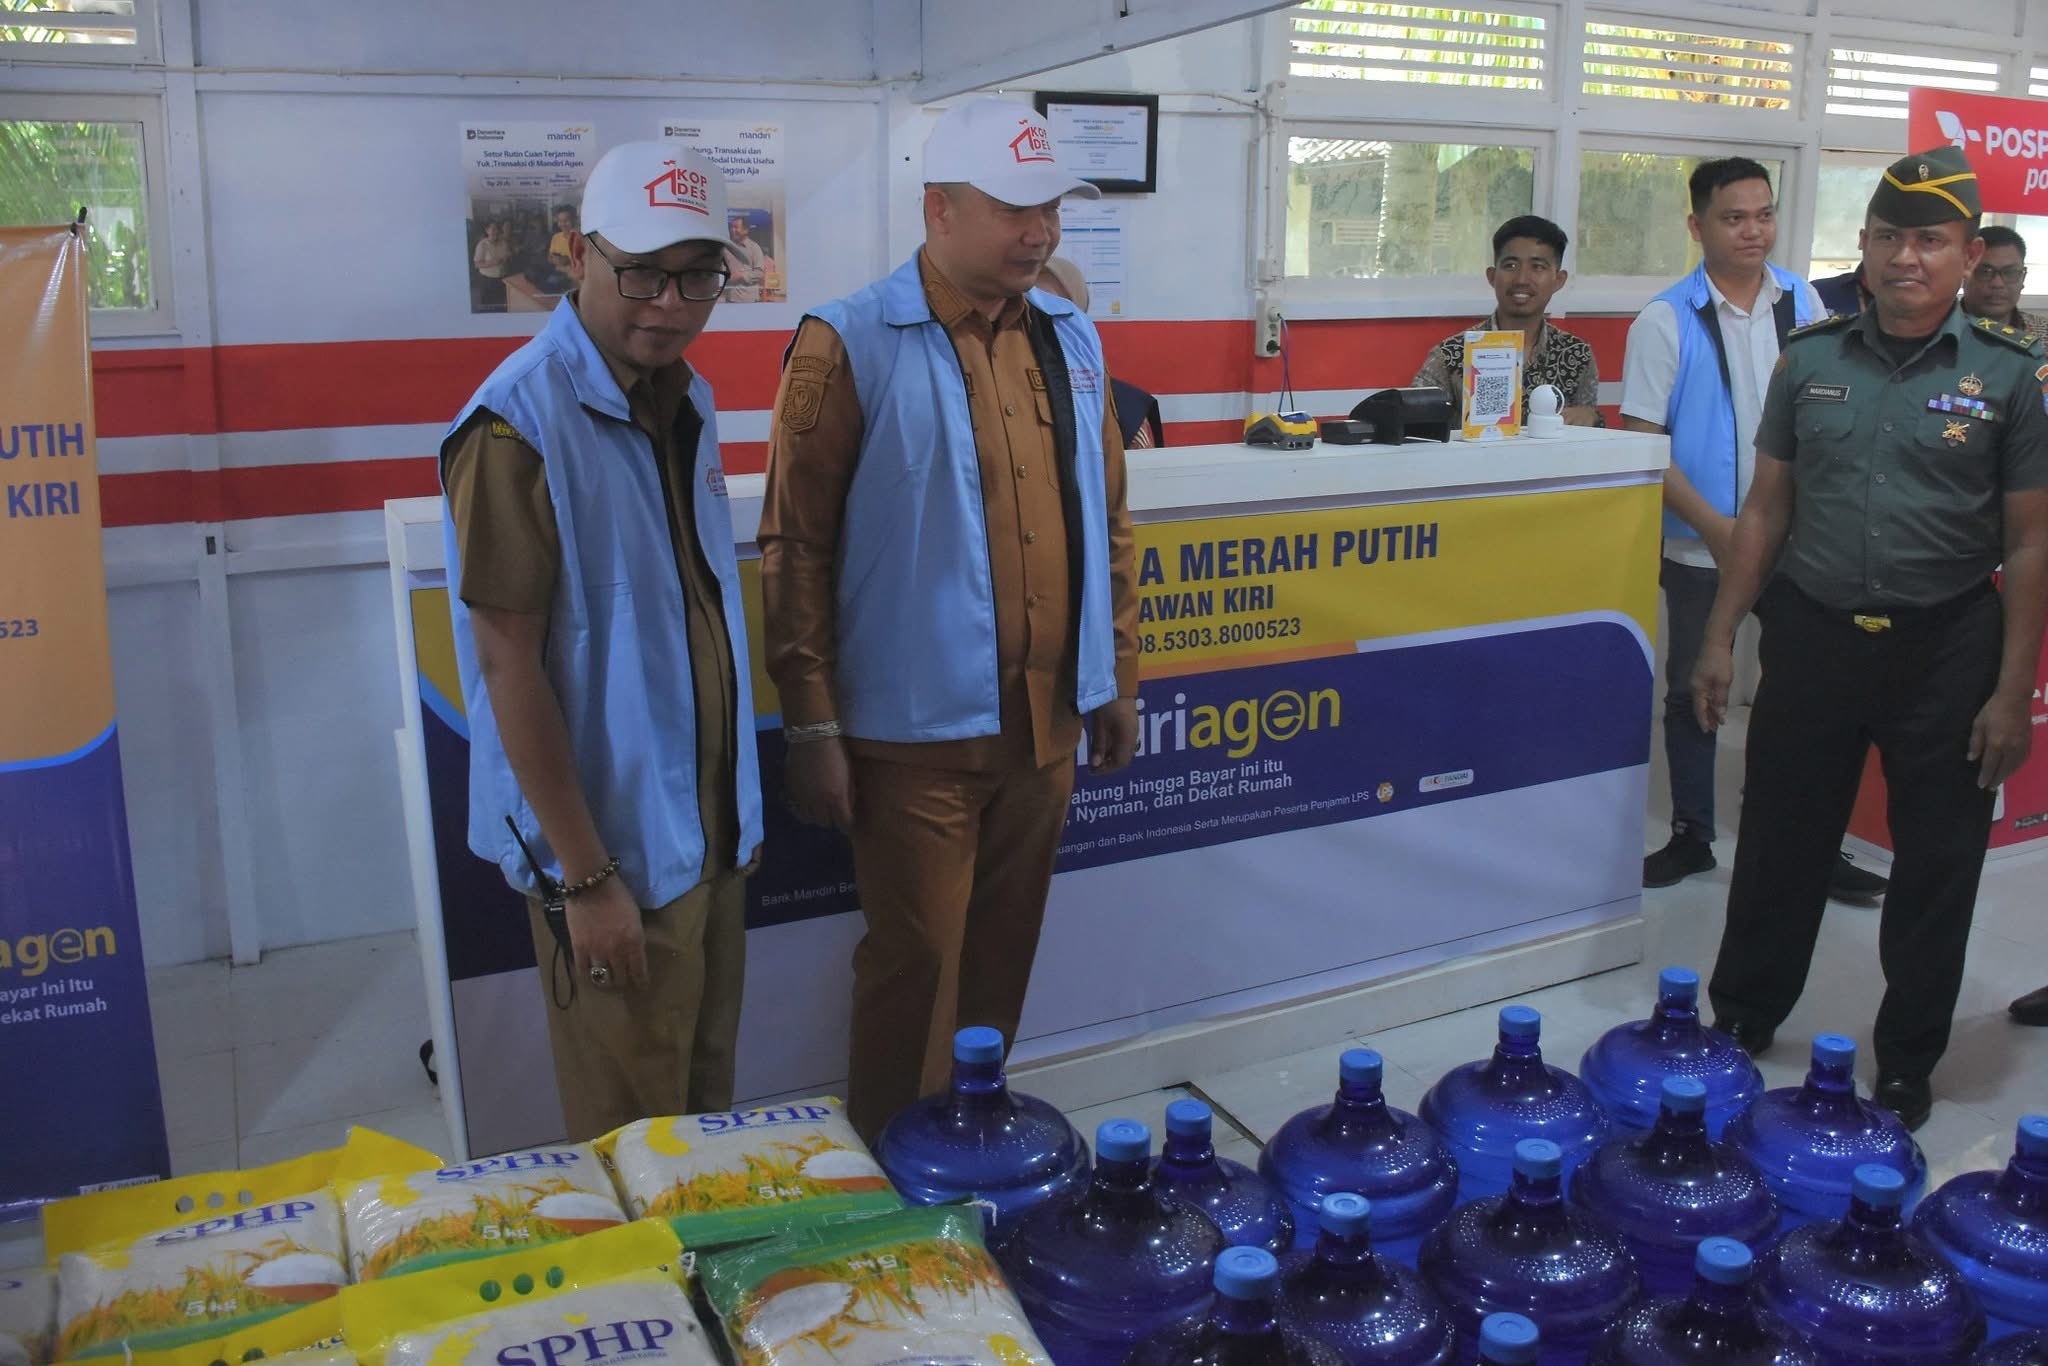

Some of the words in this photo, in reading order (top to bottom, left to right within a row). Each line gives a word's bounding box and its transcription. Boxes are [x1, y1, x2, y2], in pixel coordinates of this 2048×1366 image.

[547, 131, 580, 140] mandiri
[739, 131, 771, 139] mandiri
[483, 150, 502, 158] Setor
[544, 150, 575, 159] Terjamin
[714, 146, 746, 154] Transaksi
[566, 160, 583, 169] Agen
[746, 166, 759, 175] Aja
[677, 168, 707, 186] KOP
[677, 183, 707, 201] DES
[0, 423, 84, 460] UTIH
[7, 481, 80, 518] KIRI
[1138, 547, 1164, 586] A
[1180, 533, 1317, 582] MERAH
[1333, 523, 1438, 567] PUTIH
[1138, 590, 1213, 623] AWAN
[1224, 584, 1273, 613] KIRI
[1072, 785, 1123, 804] abung
[1129, 775, 1184, 795] hingga
[1190, 768, 1236, 785] Bayar
[1241, 761, 1259, 777] ini
[1264, 760, 1283, 773] itu
[1076, 800, 1148, 823] Nyaman,
[1154, 792, 1183, 808] dan
[1188, 783, 1234, 802] Dekat
[1238, 773, 1292, 794] Rumah
[1376, 784, 1394, 799] LPS
[1098, 836, 1116, 848] dan
[1119, 831, 1144, 844] Bank
[1147, 823, 1192, 838] Indonesia
[1194, 818, 1219, 830] Serta
[1221, 809, 1272, 825] Merupakan
[1273, 803, 1308, 816] Peserta
[1310, 795, 1350, 810] Penjamin
[1352, 791, 1370, 803] LPS
[762, 892, 791, 906] Bank
[794, 885, 836, 901] Mandiri
[41, 979, 65, 996] Ini
[69, 979, 94, 992] Itu
[45, 997, 107, 1018] Rumah
[698, 1105, 831, 1132] SPHP
[436, 1152, 580, 1181] SPHP
[759, 1185, 776, 1199] 5
[483, 1225, 500, 1240] 5
[877, 1254, 898, 1269] 5
[184, 1300, 206, 1317] 5
[497, 1319, 673, 1366] SPHP
